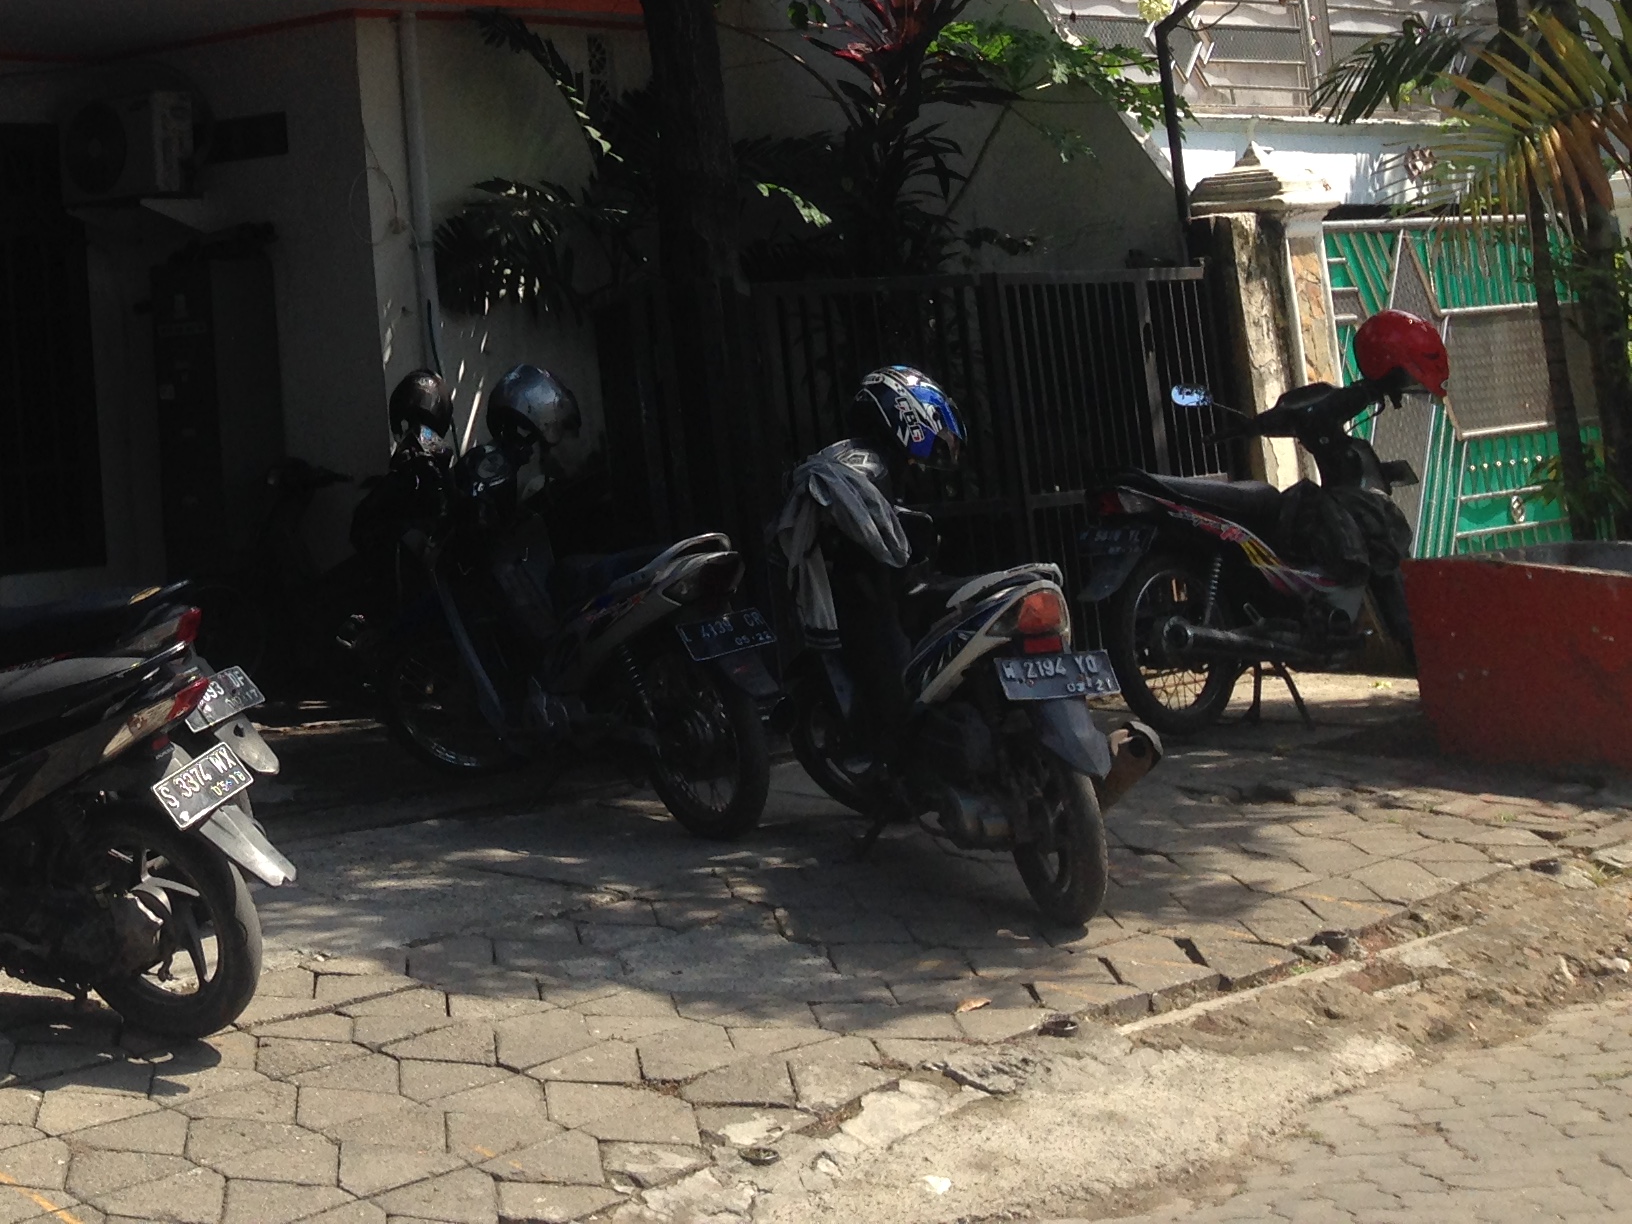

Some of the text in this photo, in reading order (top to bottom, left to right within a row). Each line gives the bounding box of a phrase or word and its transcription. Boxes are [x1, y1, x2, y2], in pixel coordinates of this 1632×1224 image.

[1024, 657, 1066, 679] 2194
[160, 747, 237, 809] S 3374 WX
